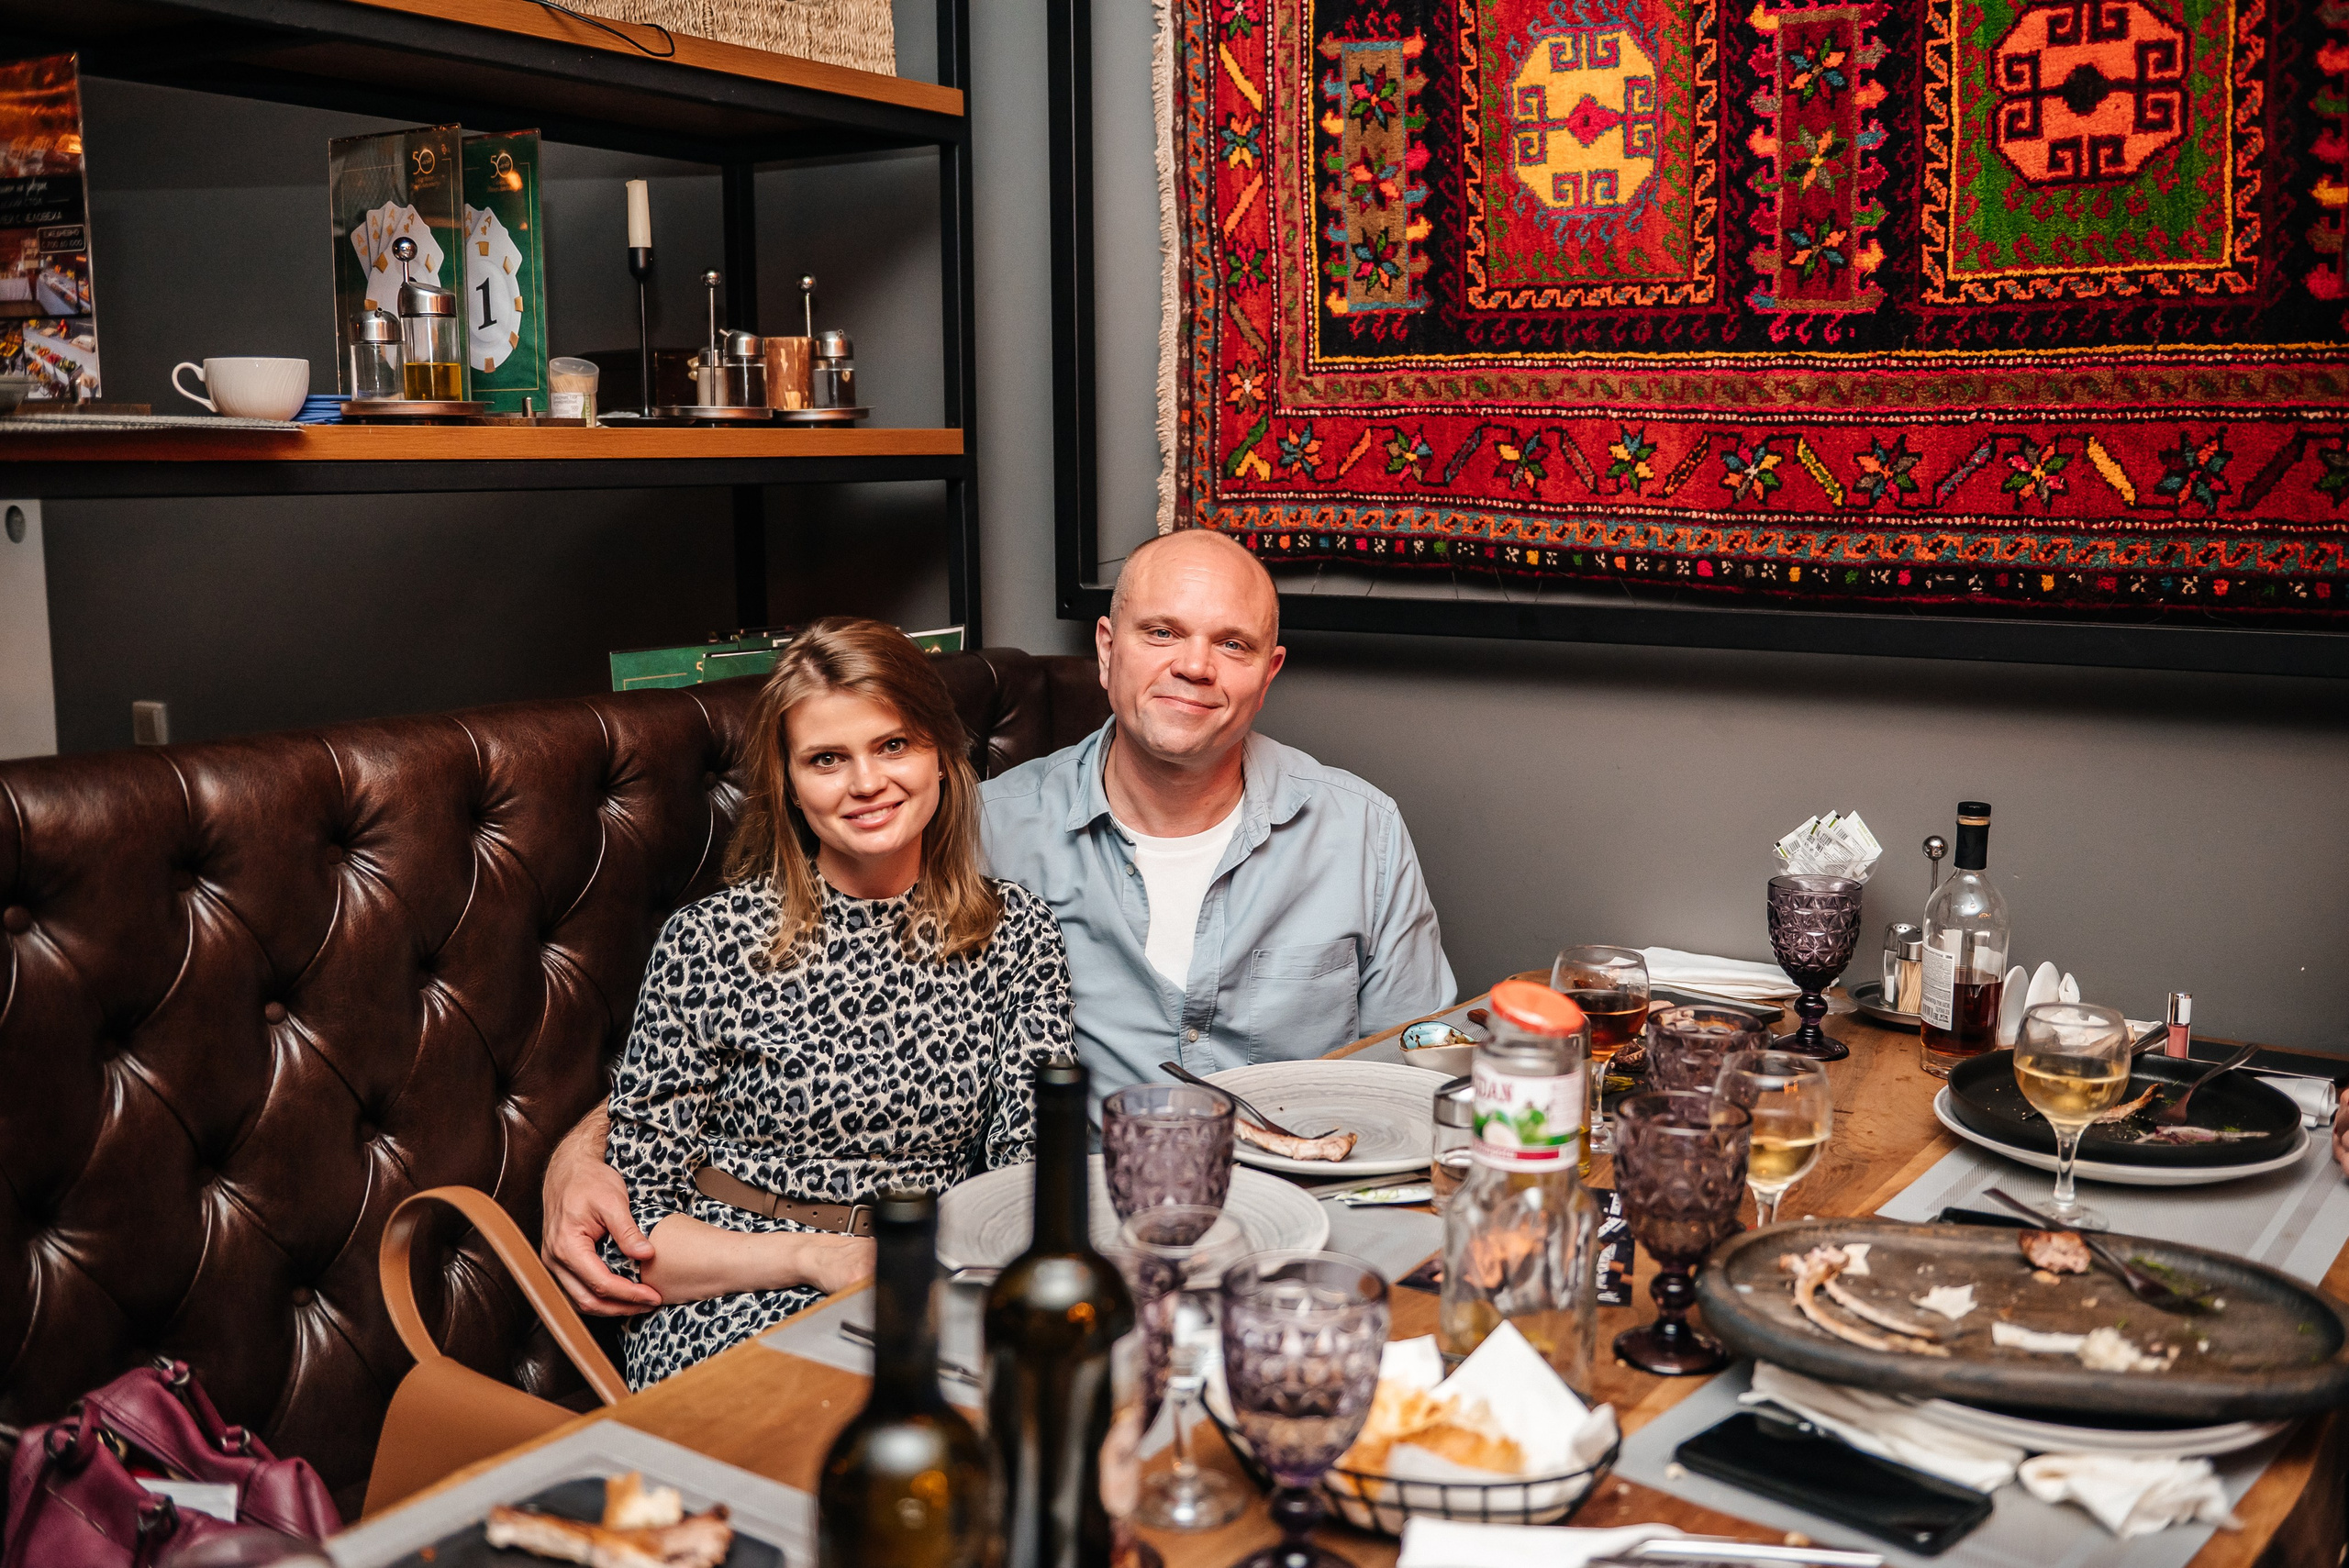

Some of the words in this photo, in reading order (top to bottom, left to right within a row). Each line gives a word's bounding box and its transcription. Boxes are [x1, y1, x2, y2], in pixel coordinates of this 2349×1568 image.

[412, 148, 436, 175] 50
[490, 151, 514, 179] 50
[371, 215, 379, 228] A
[388, 208, 395, 221] A
[407, 212, 415, 226] A
[484, 215, 493, 228] A
[476, 277, 497, 330] 1
